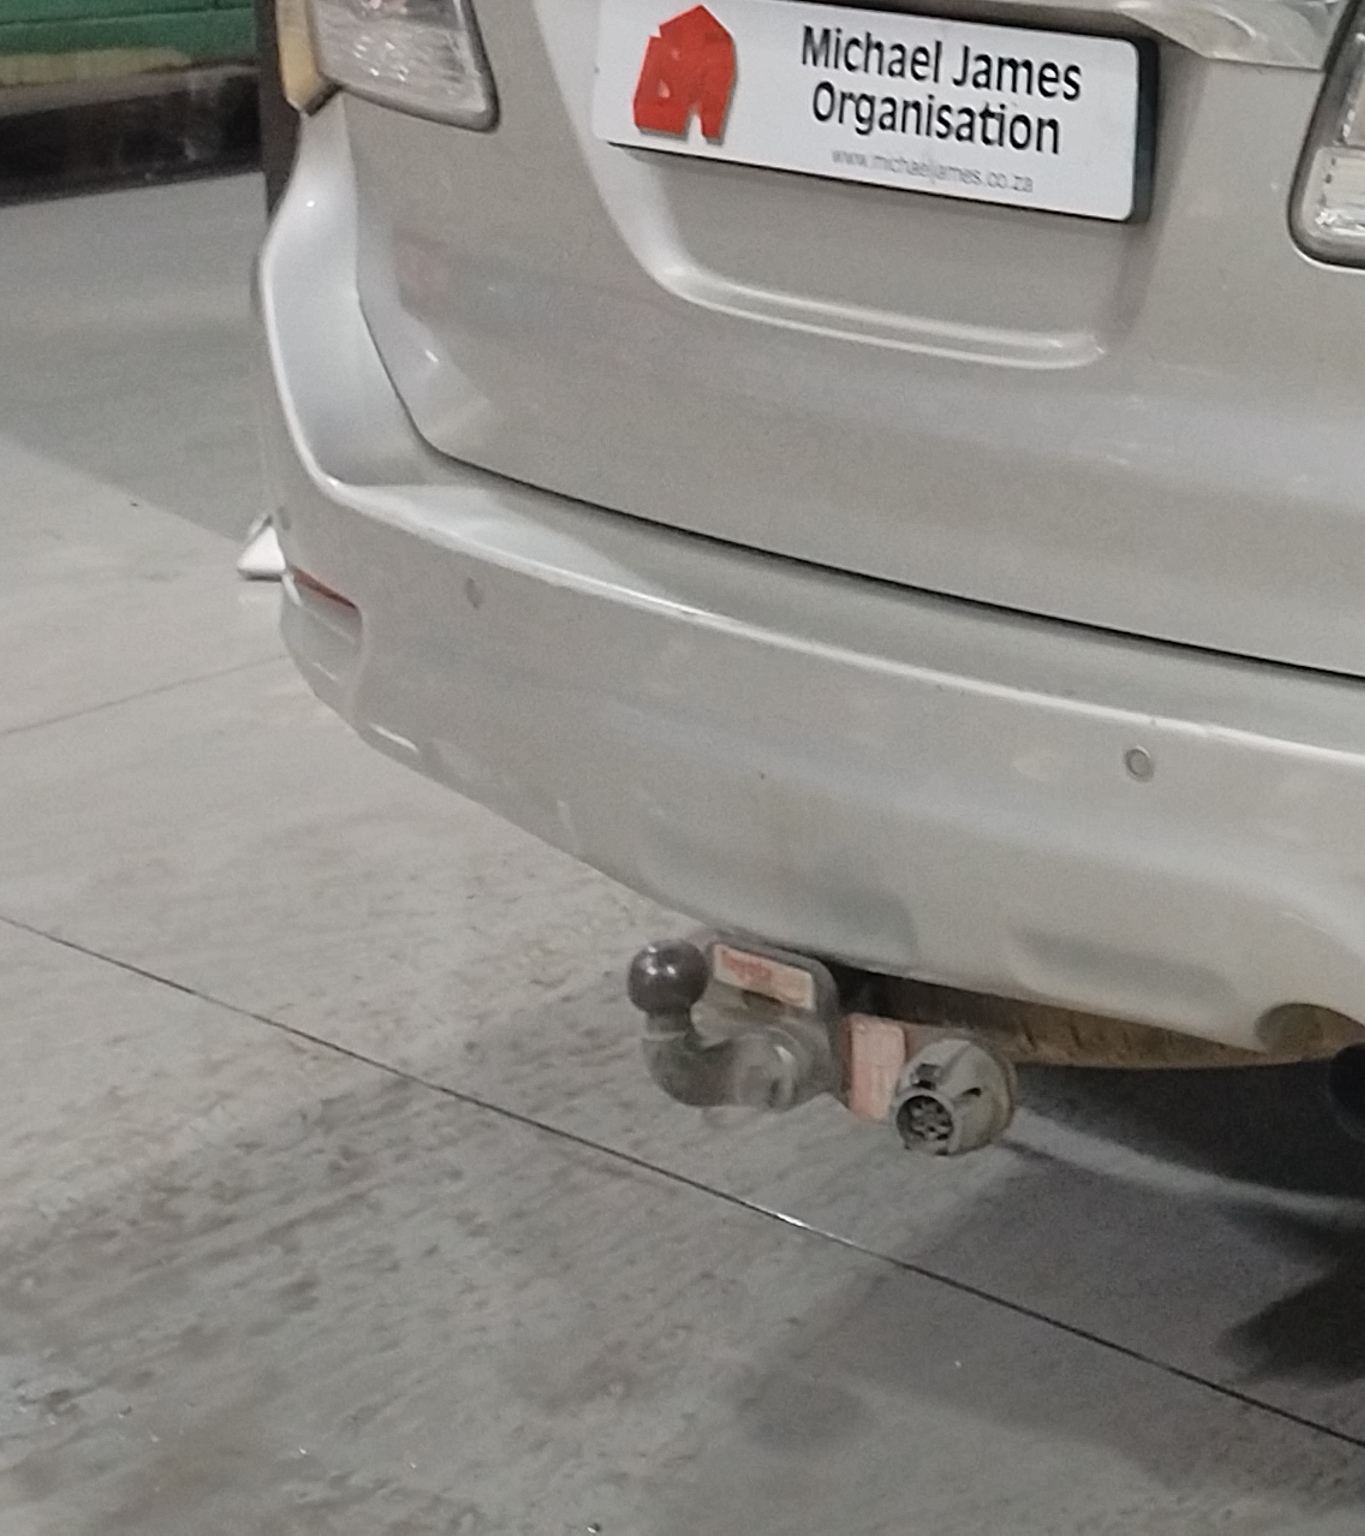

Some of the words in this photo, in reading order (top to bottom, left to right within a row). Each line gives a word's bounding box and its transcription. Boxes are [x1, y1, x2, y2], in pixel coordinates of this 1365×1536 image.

[801, 25, 943, 84] Michael
[952, 44, 1082, 101] James
[812, 80, 1060, 155] Organisation
